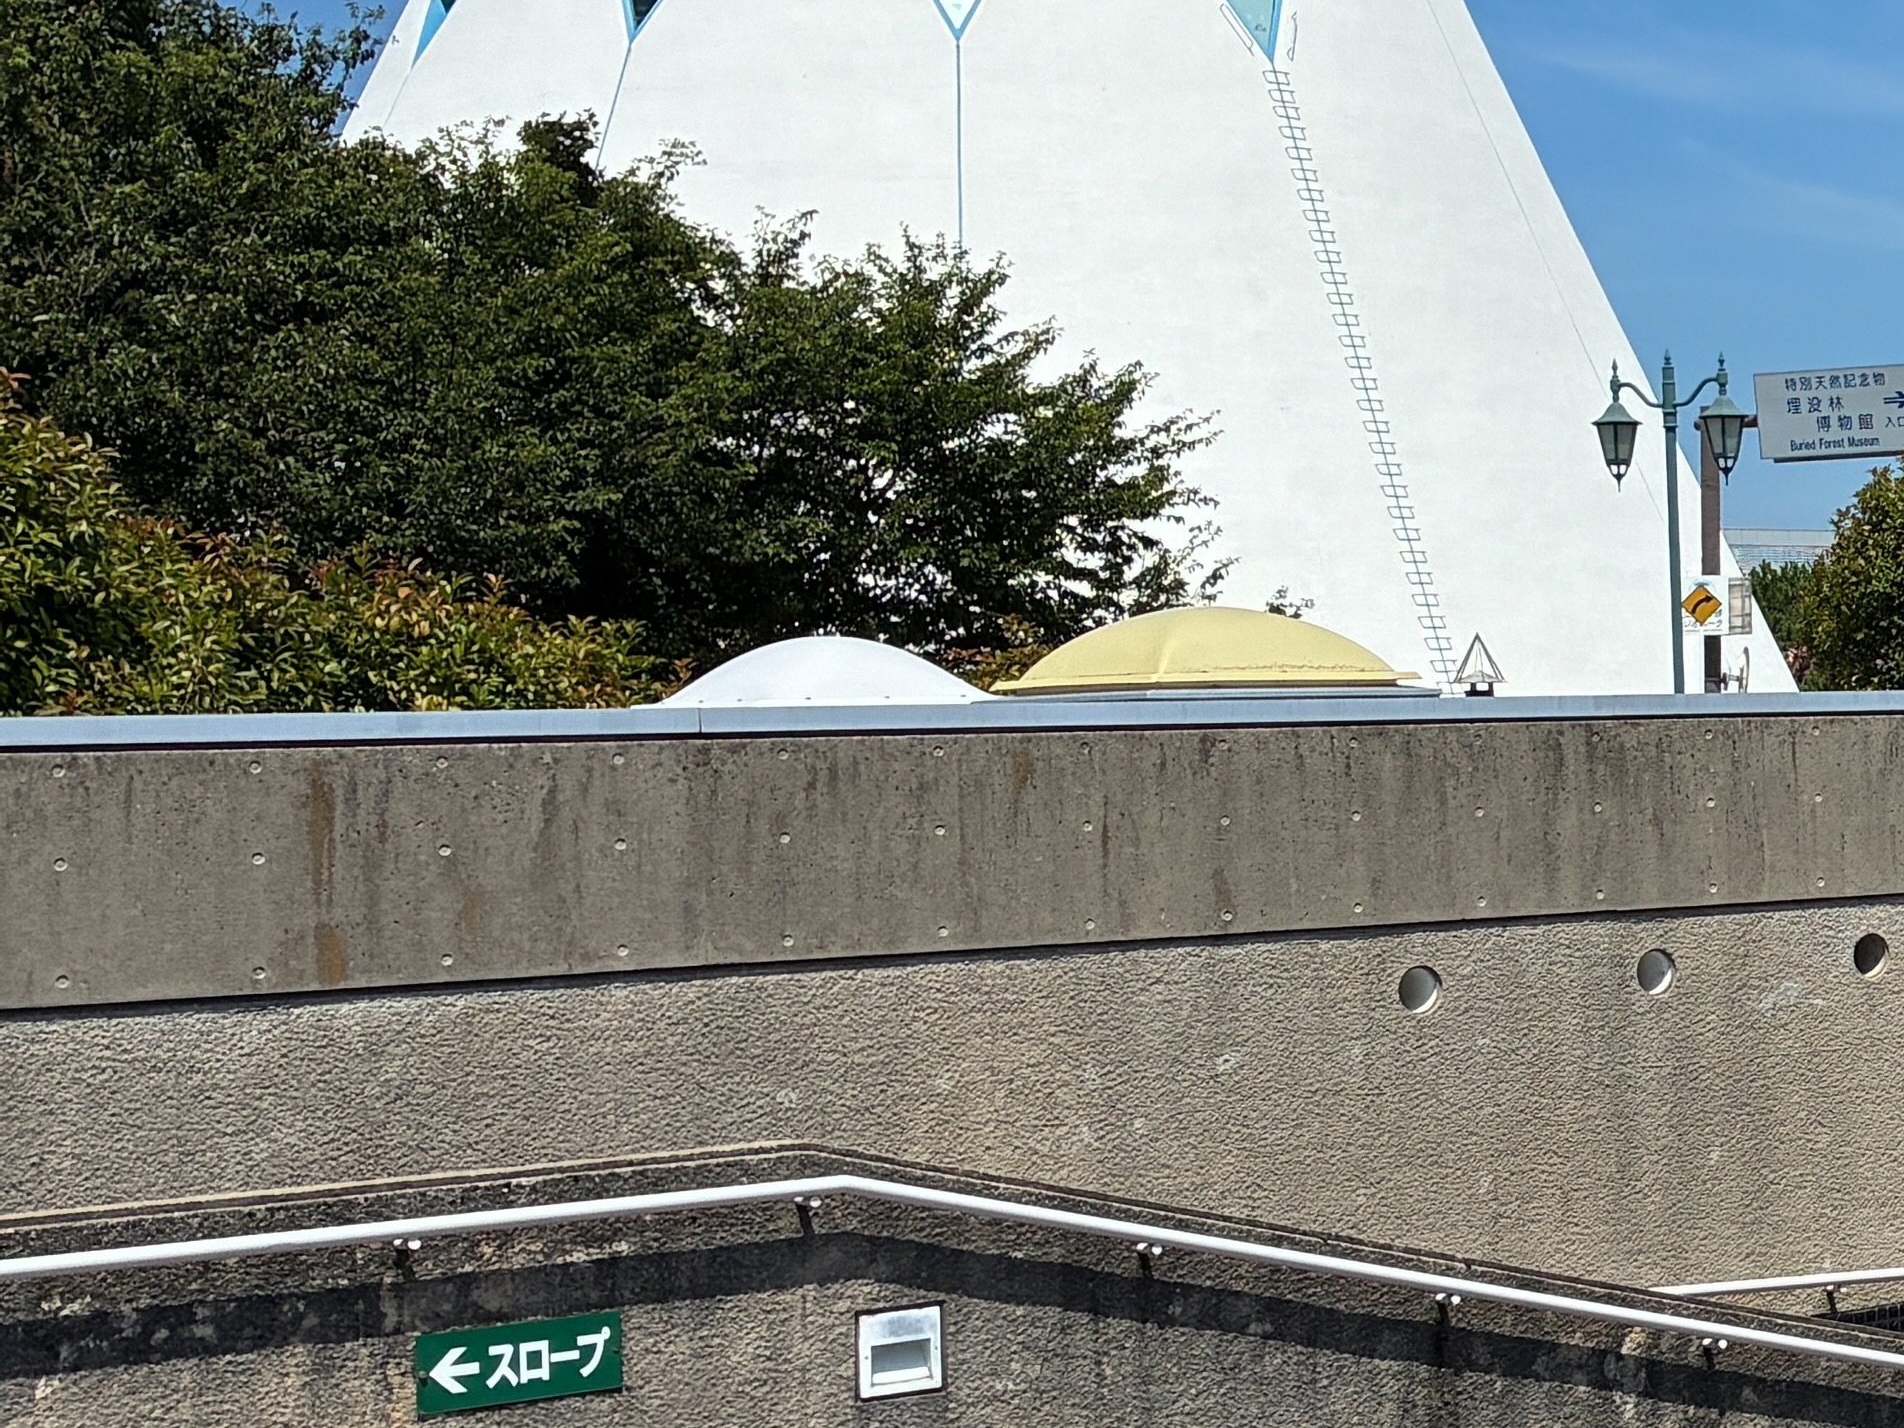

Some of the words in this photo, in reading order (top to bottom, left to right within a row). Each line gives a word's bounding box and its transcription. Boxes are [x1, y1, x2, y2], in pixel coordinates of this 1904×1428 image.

[1784, 372, 1886, 392] 特別天然記念物
[1786, 395, 1845, 415] 埋没林
[1816, 413, 1875, 433] 博物館
[1790, 439, 1816, 452] Buried
[1819, 437, 1846, 449] Forest
[1847, 436, 1880, 448] Museum
[485, 1326, 610, 1389] スロープ
